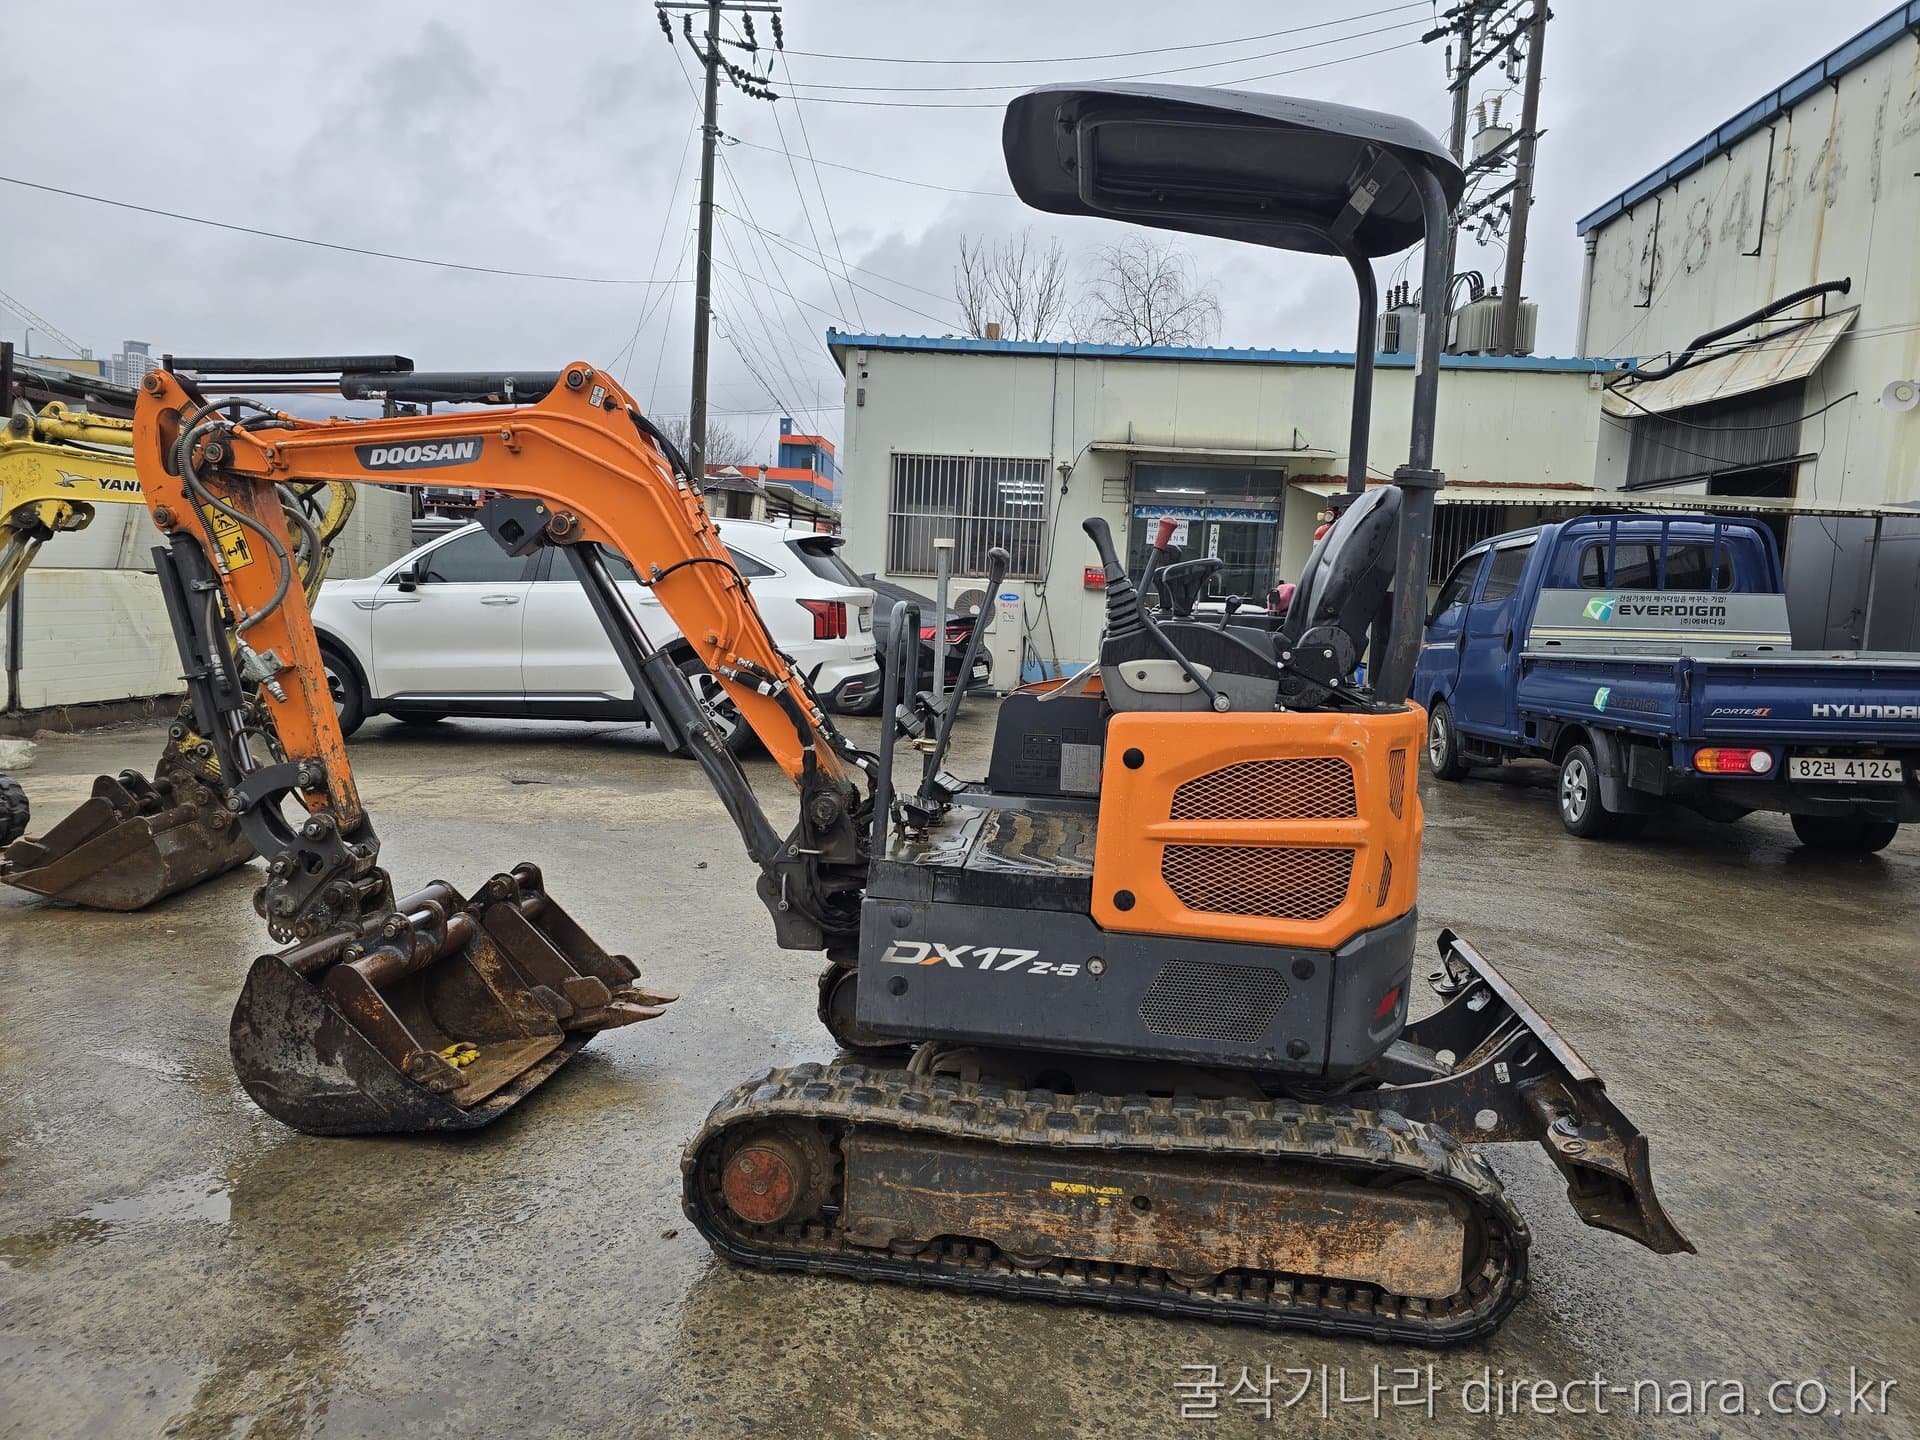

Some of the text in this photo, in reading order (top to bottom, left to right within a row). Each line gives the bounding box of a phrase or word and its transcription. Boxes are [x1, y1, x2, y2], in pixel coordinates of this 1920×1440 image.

[369, 441, 475, 466] DOOSAN
[1618, 605, 1726, 616] EVERDIGM
[1800, 760, 1892, 778] 82러 4126
[880, 940, 1039, 971] DX17
